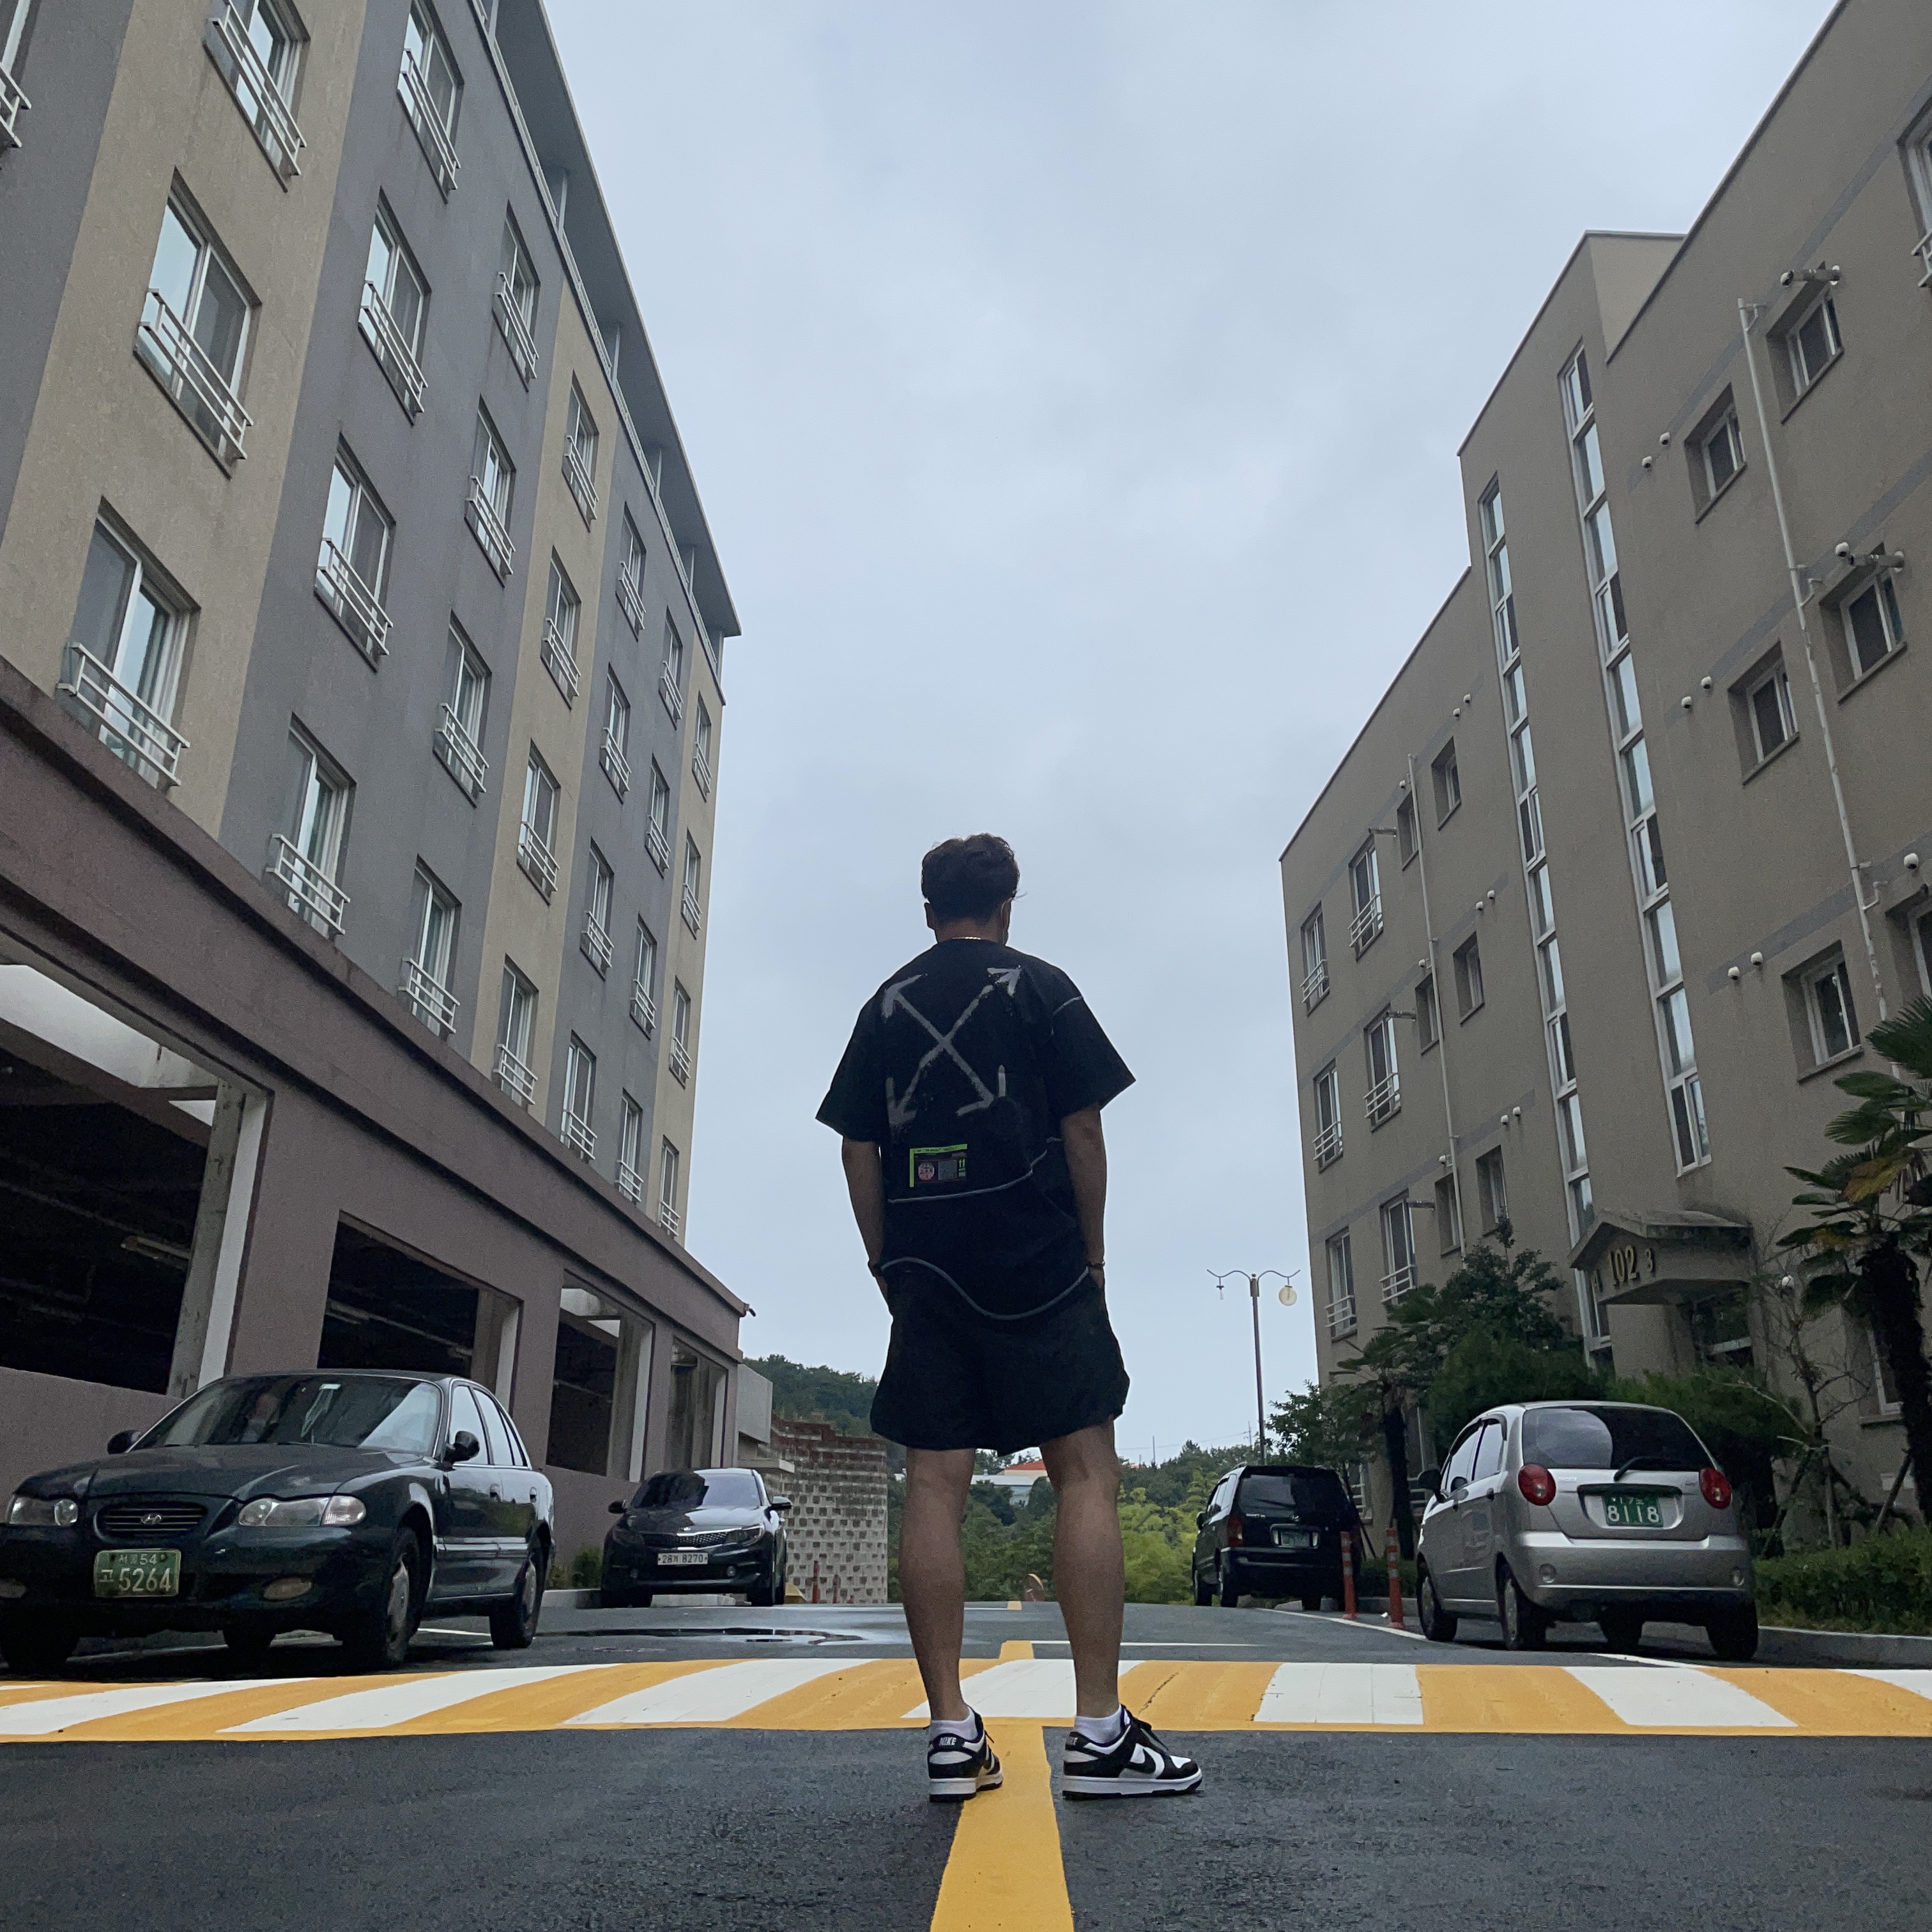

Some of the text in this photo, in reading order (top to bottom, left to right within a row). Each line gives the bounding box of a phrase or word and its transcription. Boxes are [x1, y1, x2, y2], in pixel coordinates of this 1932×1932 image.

[1608, 1245, 1637, 1283] 102
[1607, 1505, 1660, 1523] 8118
[682, 1554, 703, 1563] 8270
[118, 1567, 171, 1591] 5264
[939, 1736, 957, 1746] NIKE
